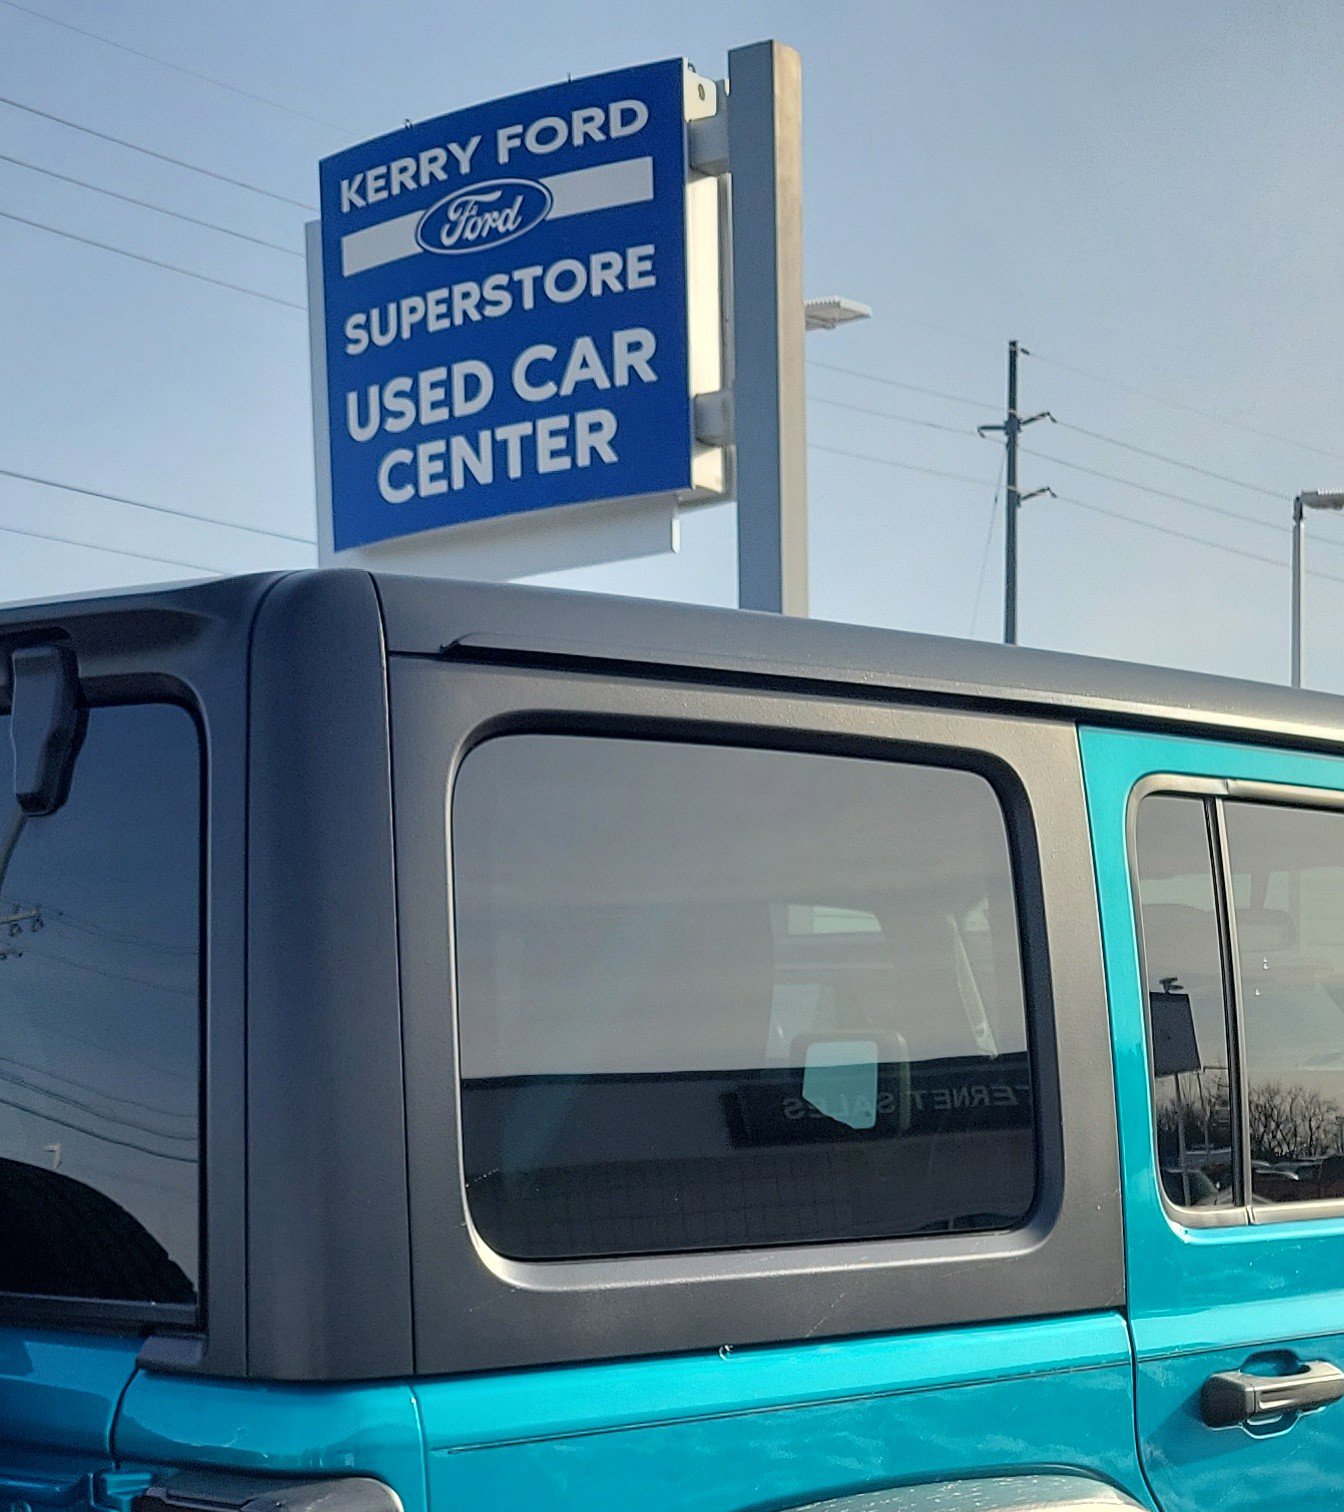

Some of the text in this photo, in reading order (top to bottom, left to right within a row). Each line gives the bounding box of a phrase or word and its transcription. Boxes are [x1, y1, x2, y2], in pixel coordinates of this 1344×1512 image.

[340, 98, 650, 213] KERRY FORD
[439, 187, 524, 248] Ford
[344, 245, 656, 355] SUPERSTORE
[346, 328, 658, 443] USED CAR
[378, 409, 619, 504] CENTER
